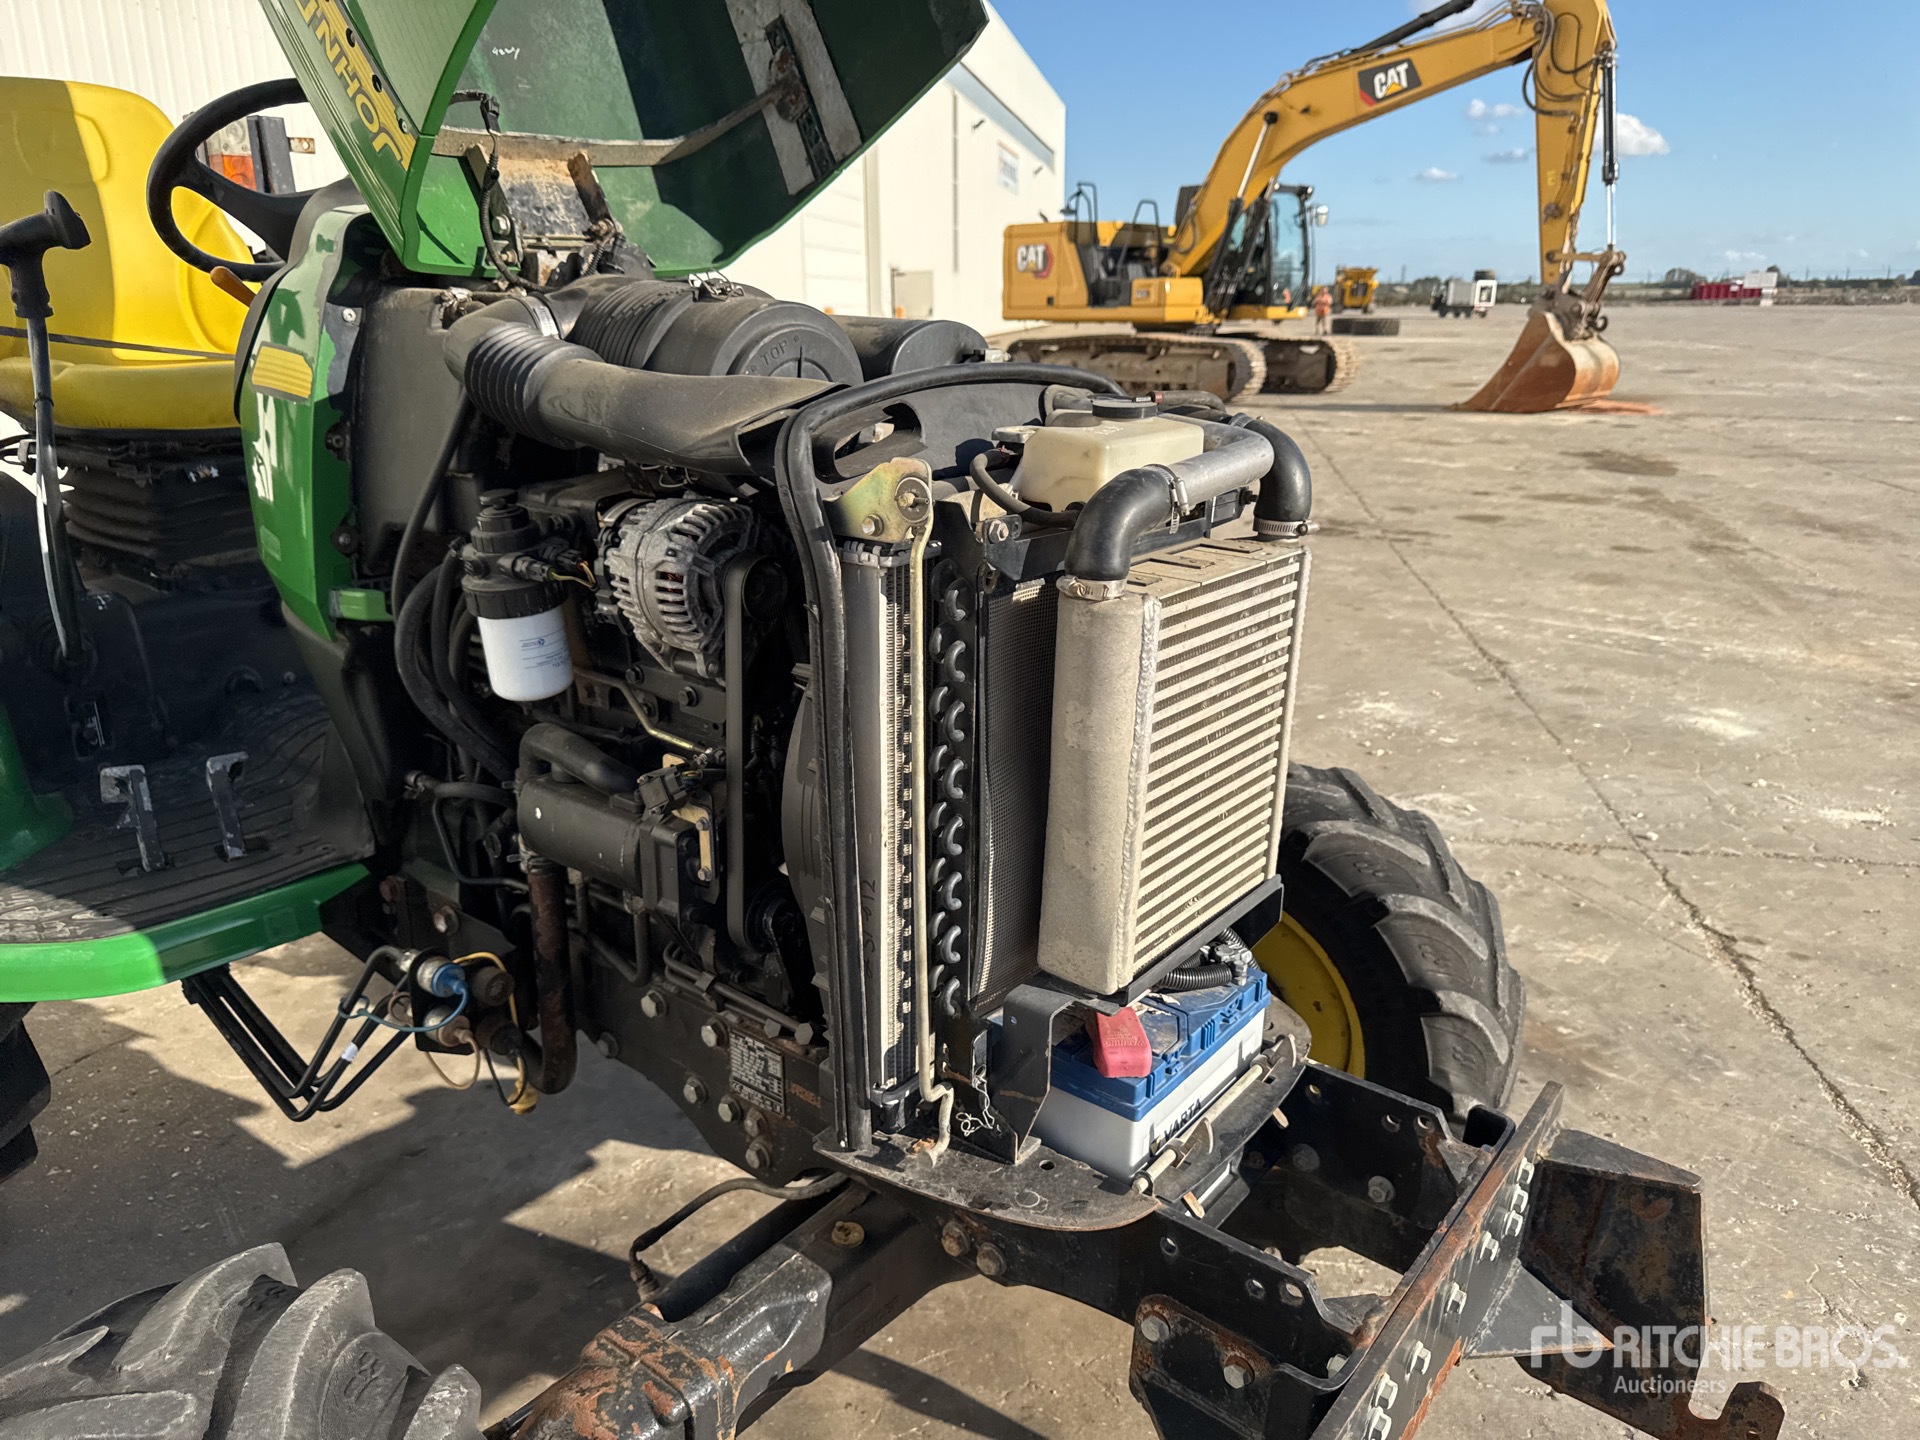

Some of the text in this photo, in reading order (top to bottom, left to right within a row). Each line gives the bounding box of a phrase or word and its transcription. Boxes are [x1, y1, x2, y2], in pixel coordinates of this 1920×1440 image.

[315, 20, 402, 161] JOHN
[1373, 61, 1408, 99] CAT
[1017, 244, 1046, 272] CAT
[760, 340, 787, 366] TOP
[1164, 1098, 1201, 1141] VARTA
